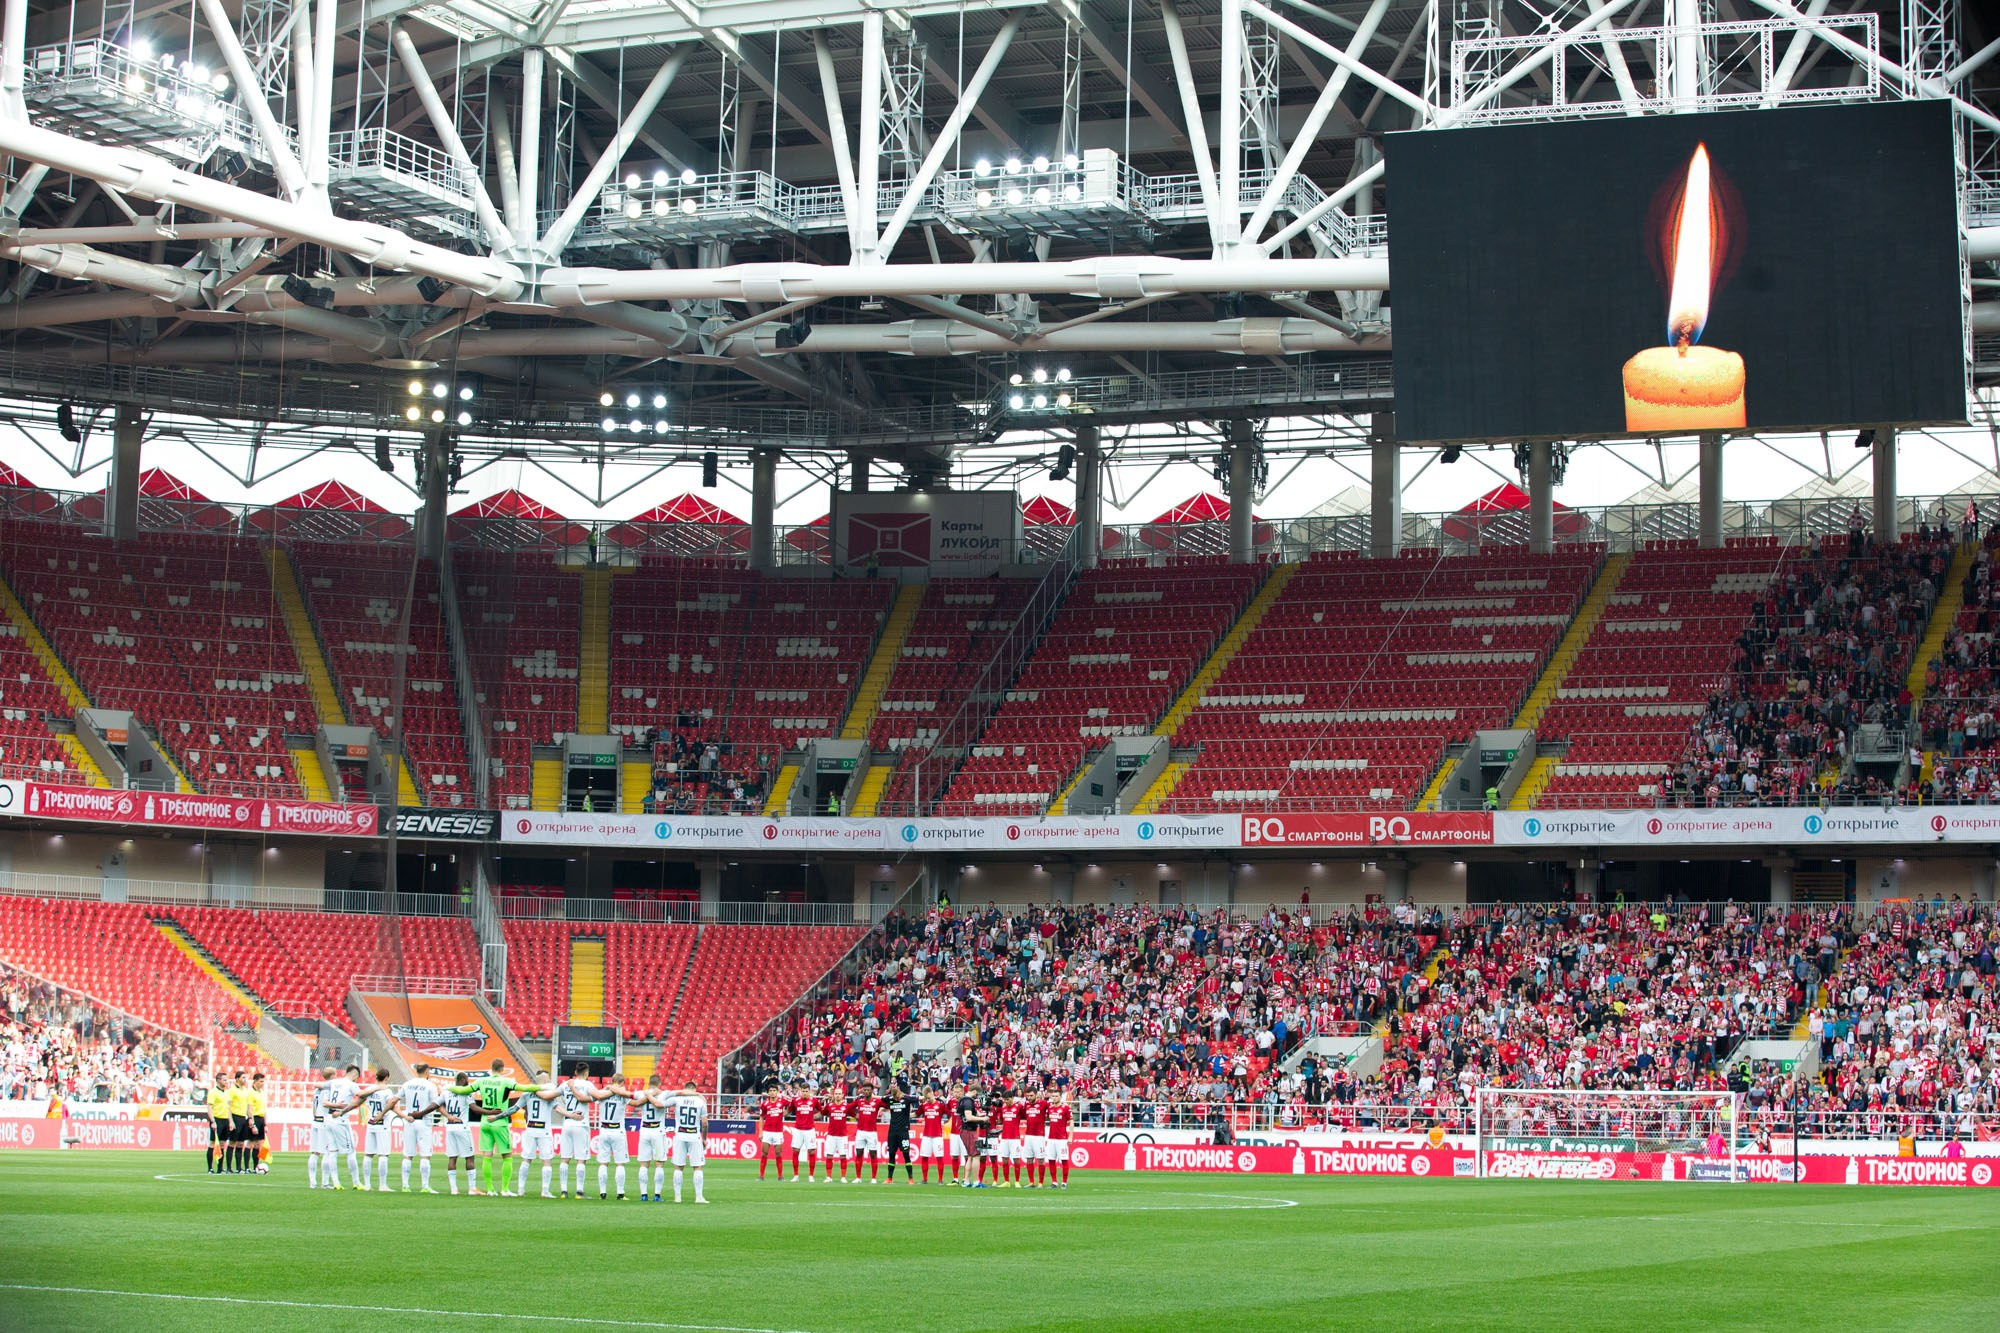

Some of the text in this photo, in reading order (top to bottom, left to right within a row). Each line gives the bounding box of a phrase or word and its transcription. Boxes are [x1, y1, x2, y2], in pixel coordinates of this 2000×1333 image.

[941, 521, 983, 533] Карты
[940, 536, 1000, 548] ЛУКОЙЛ
[386, 815, 493, 834] GENESIS
[536, 822, 636, 835] открытие арена
[1159, 824, 1224, 837] открытие
[1244, 818, 1285, 841] BQ
[1369, 817, 1411, 841] BQ
[1546, 821, 1616, 834] открытие
[1667, 820, 1772, 831] открытие арена
[1827, 819, 1899, 832] открытие
[1951, 819, 2000, 830] открыт
[677, 826, 744, 838] открытие
[782, 826, 881, 838] открытие арена
[923, 828, 985, 839] открытие
[1024, 826, 1120, 837] открытие арена
[1288, 831, 1363, 841] СМАРТФОНЫ
[1414, 830, 1491, 840] СМАРТФОНЫ
[413, 1093, 419, 1111] 4
[485, 1088, 498, 1106] 31
[448, 1100, 461, 1117] 44
[532, 1101, 540, 1119] 9
[605, 1102, 616, 1120] 17
[647, 1102, 654, 1119] 5
[680, 1107, 697, 1125] 56
